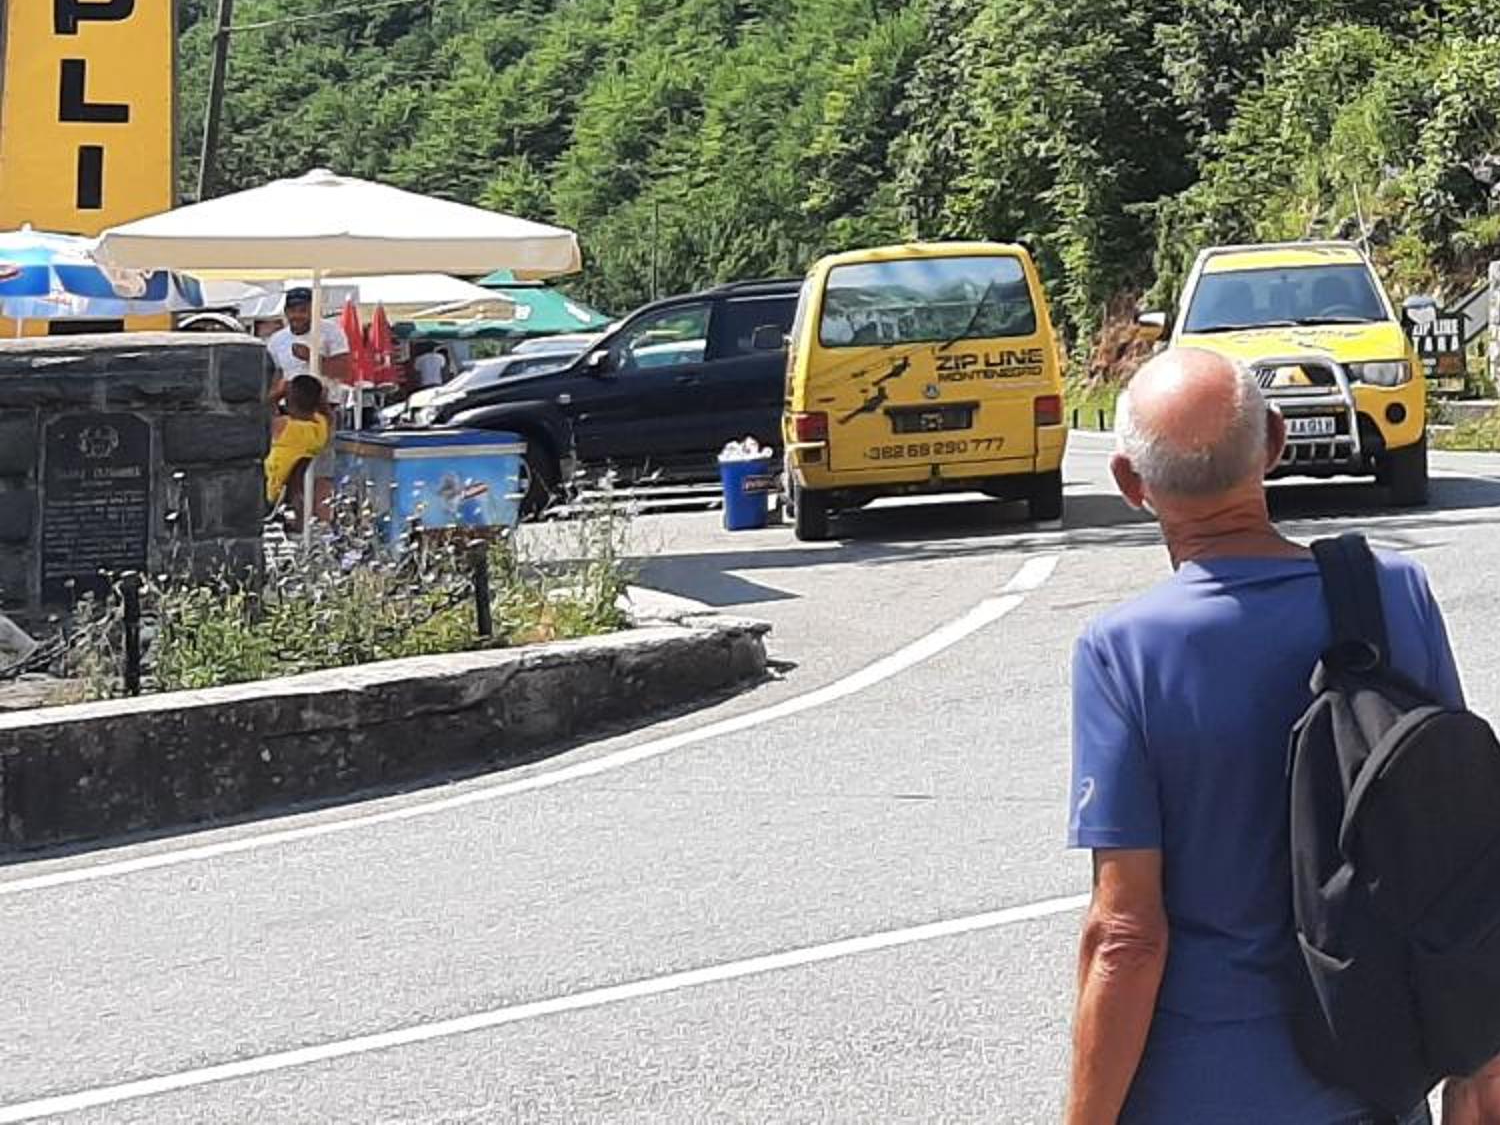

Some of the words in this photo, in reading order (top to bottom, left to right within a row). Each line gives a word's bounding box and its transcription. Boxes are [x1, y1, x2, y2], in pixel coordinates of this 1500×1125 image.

[1412, 336, 1459, 353] TARA
[935, 353, 978, 371] ZIP
[984, 348, 1044, 367] LINE
[938, 365, 1043, 381] MONTENEGRO
[970, 437, 1005, 452] 777
